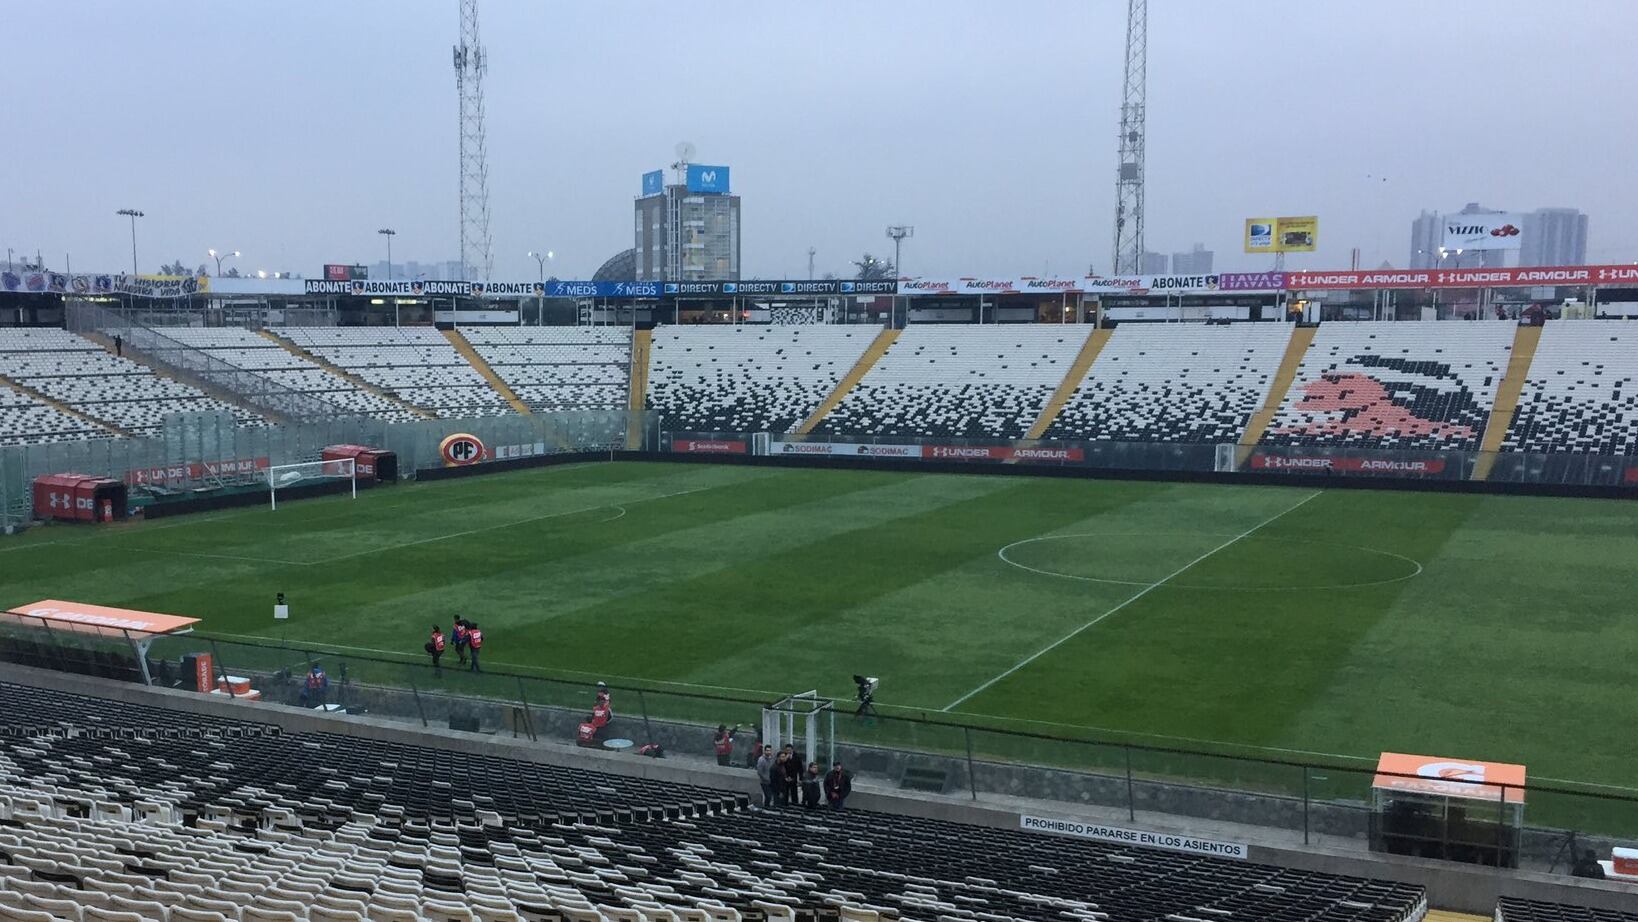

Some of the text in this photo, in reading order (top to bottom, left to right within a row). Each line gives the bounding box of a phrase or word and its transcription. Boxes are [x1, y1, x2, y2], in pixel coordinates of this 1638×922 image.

[1151, 276, 1203, 289] ABONATE
[1220, 274, 1283, 289] HAVAS
[1307, 275, 1358, 285] UNDER
[1456, 273, 1511, 282] UNDER
[306, 281, 350, 293] ABONATE
[365, 282, 410, 294] ABONATE
[424, 281, 471, 294] ABONATE
[485, 283, 532, 294] ABONATE
[566, 286, 598, 295] MEDS
[626, 286, 657, 296] MEDS
[680, 284, 718, 293] DIRECTV
[738, 283, 777, 293] DIRECTV
[797, 282, 836, 292] DIRECTV
[856, 282, 895, 292] DIRECTV
[453, 441, 474, 460] PF
[795, 445, 833, 453] SODIMAC
[869, 447, 908, 455] SODIMAC
[949, 448, 990, 457] UNDER
[1282, 458, 1331, 468] UNDER
[151, 467, 191, 480] UNDER
[1025, 817, 1241, 856] PROHIBIDO PARARSE EN LOS ASIENTOS
